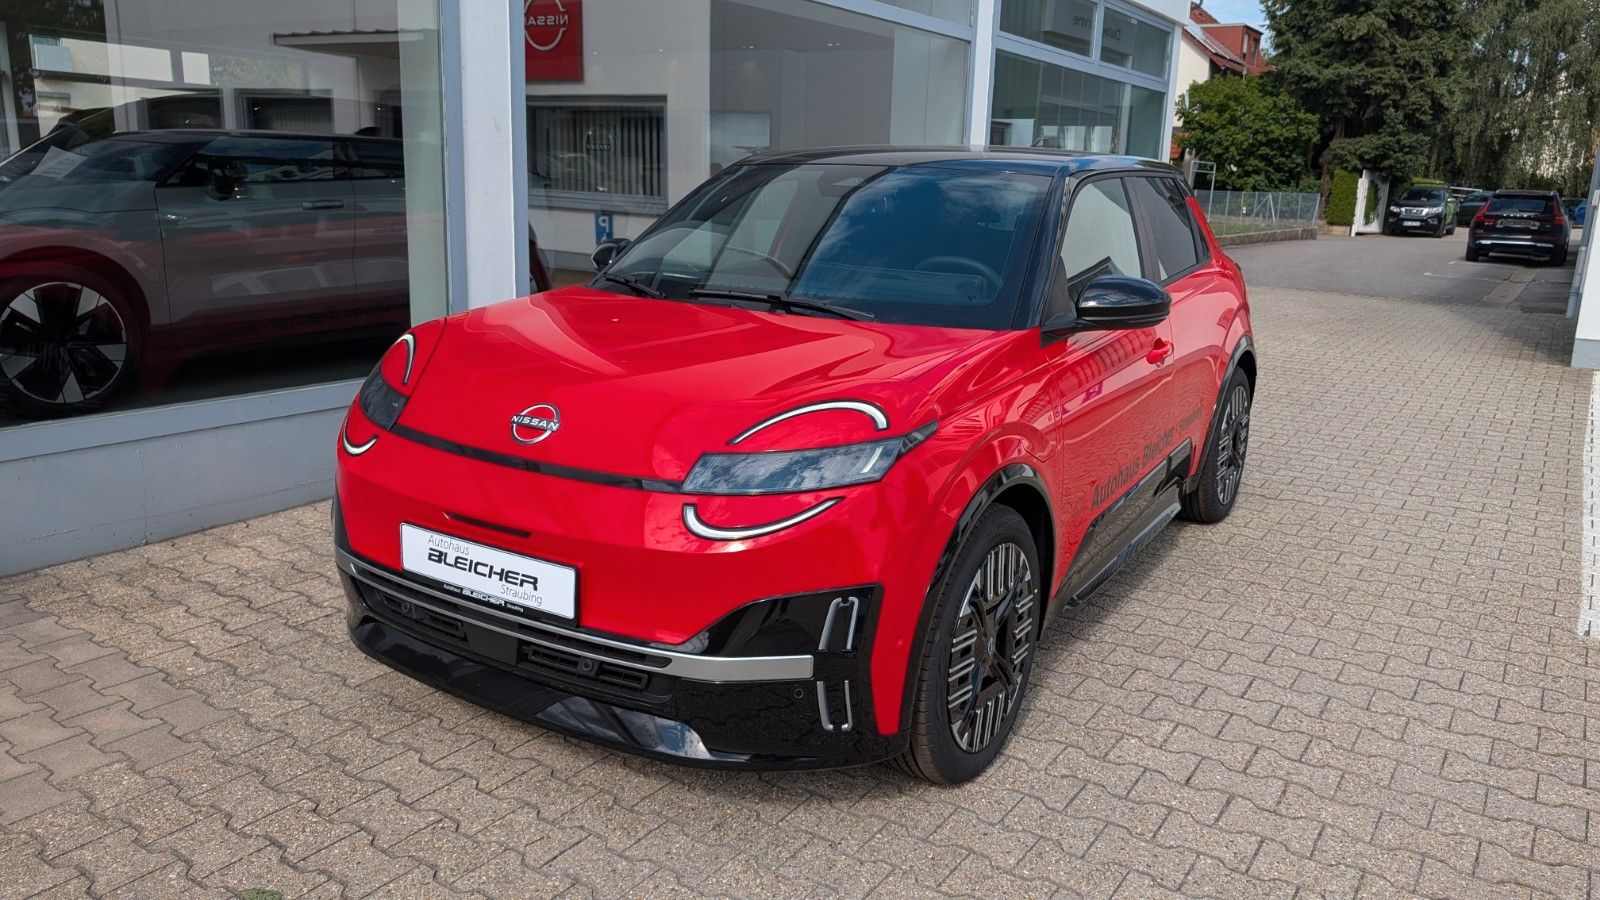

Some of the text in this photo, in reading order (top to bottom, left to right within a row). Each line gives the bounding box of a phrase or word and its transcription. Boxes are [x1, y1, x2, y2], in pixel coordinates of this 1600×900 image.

[511, 415, 559, 430] NISSAN
[1091, 456, 1140, 511] Autohaus
[428, 534, 470, 555] Autohaus
[428, 547, 538, 591] BLEICHER
[462, 588, 505, 606] BLEICHER
[500, 583, 543, 606] Straubing
